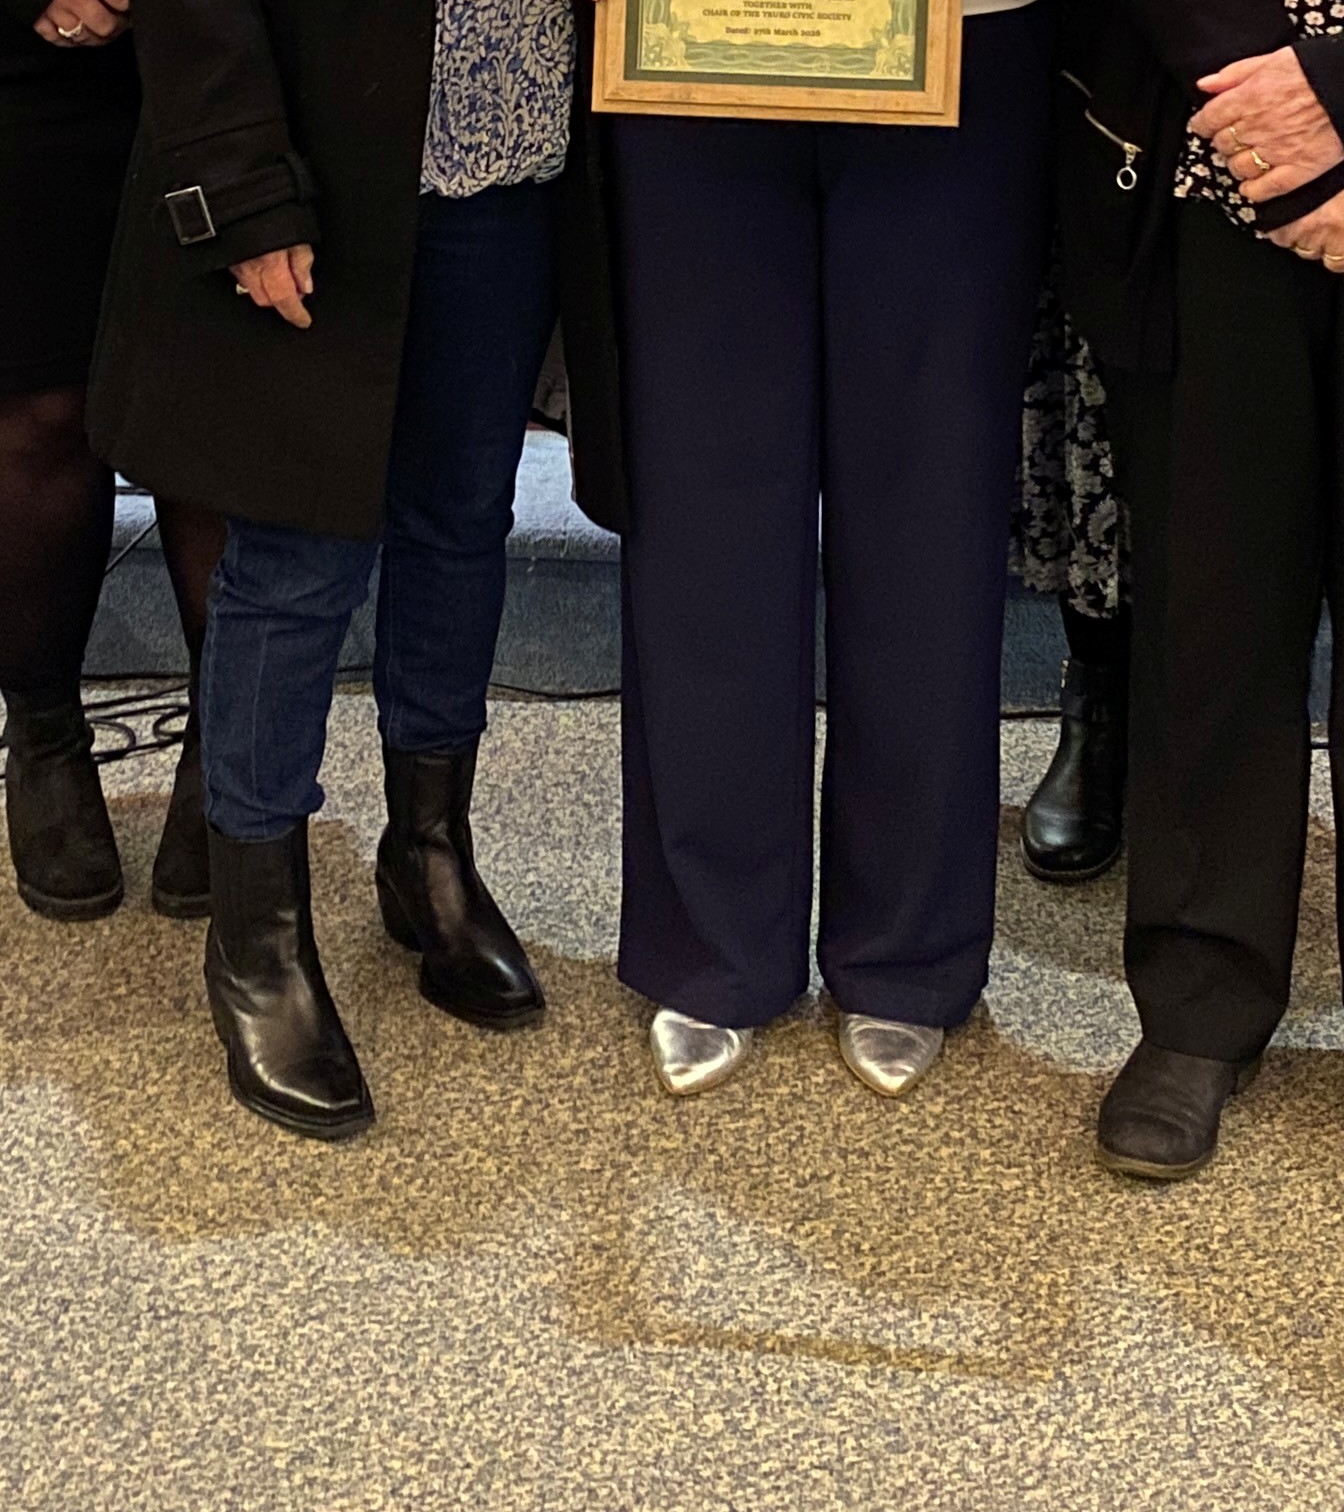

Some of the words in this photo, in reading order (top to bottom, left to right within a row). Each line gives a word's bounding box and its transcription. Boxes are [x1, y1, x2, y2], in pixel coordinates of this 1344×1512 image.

[743, 1, 787, 9] TOGETHER
[790, 2, 812, 10] WITH
[702, 9, 728, 17] CHAIR
[743, 10, 760, 18] THE
[762, 11, 790, 19] TRURO
[792, 12, 814, 20] CIVIC
[817, 13, 852, 21] SOCIETY
[774, 29, 798, 37] March
